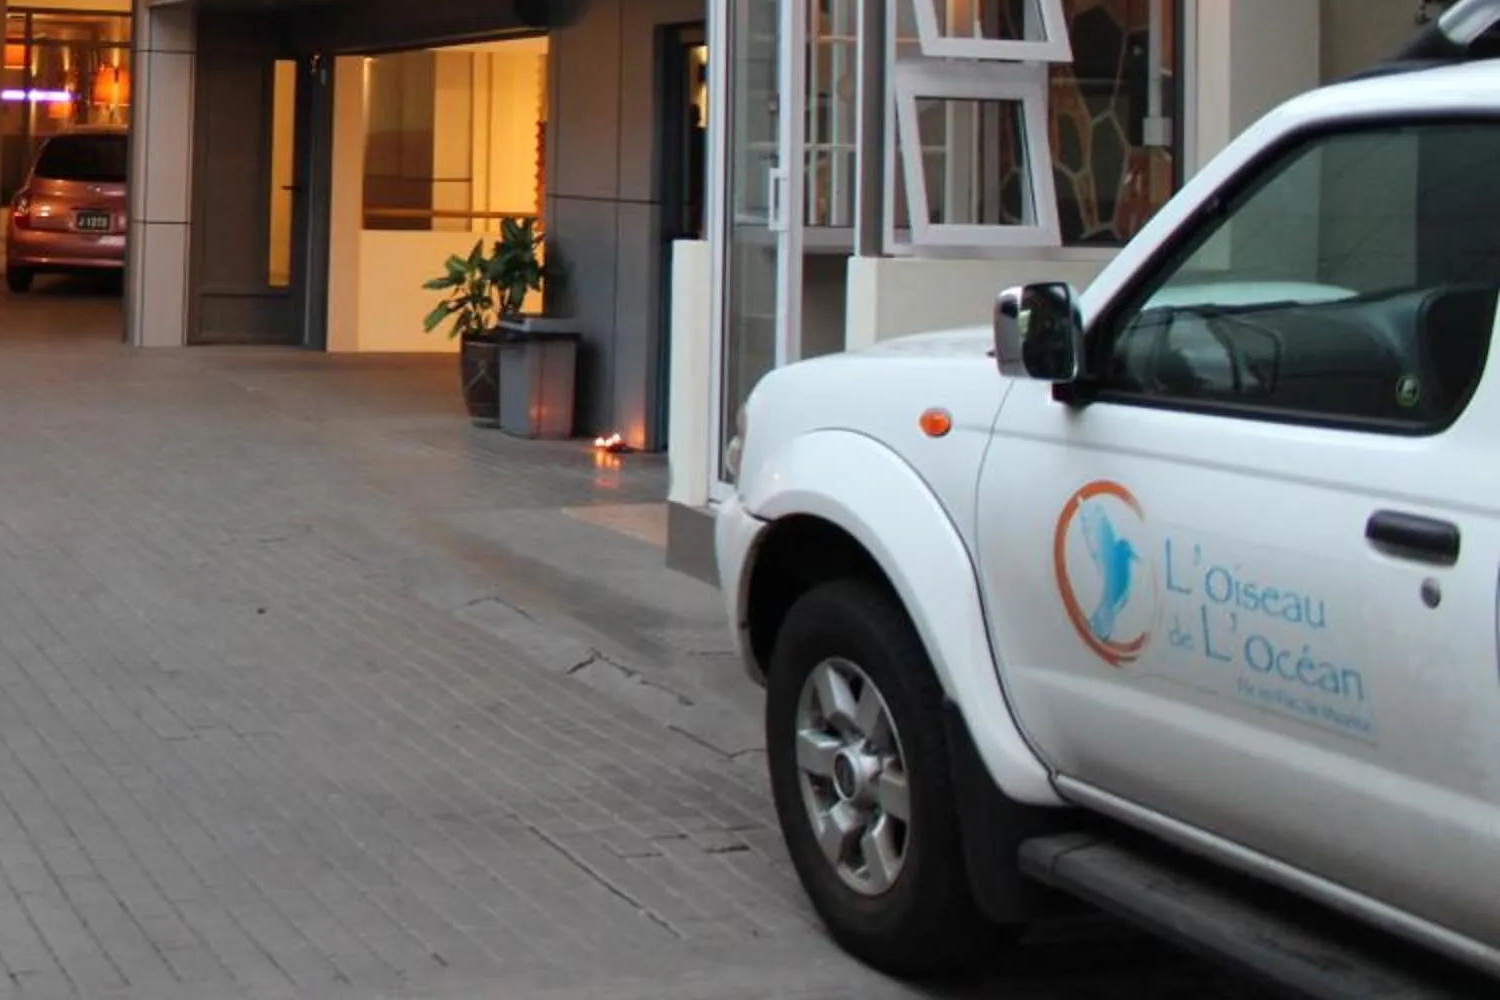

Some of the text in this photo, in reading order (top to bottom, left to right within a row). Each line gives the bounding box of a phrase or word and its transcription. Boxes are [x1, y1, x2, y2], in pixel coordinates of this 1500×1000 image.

[1165, 538, 1325, 628] L'Oiseau
[1169, 604, 1364, 701] de L'Océan
